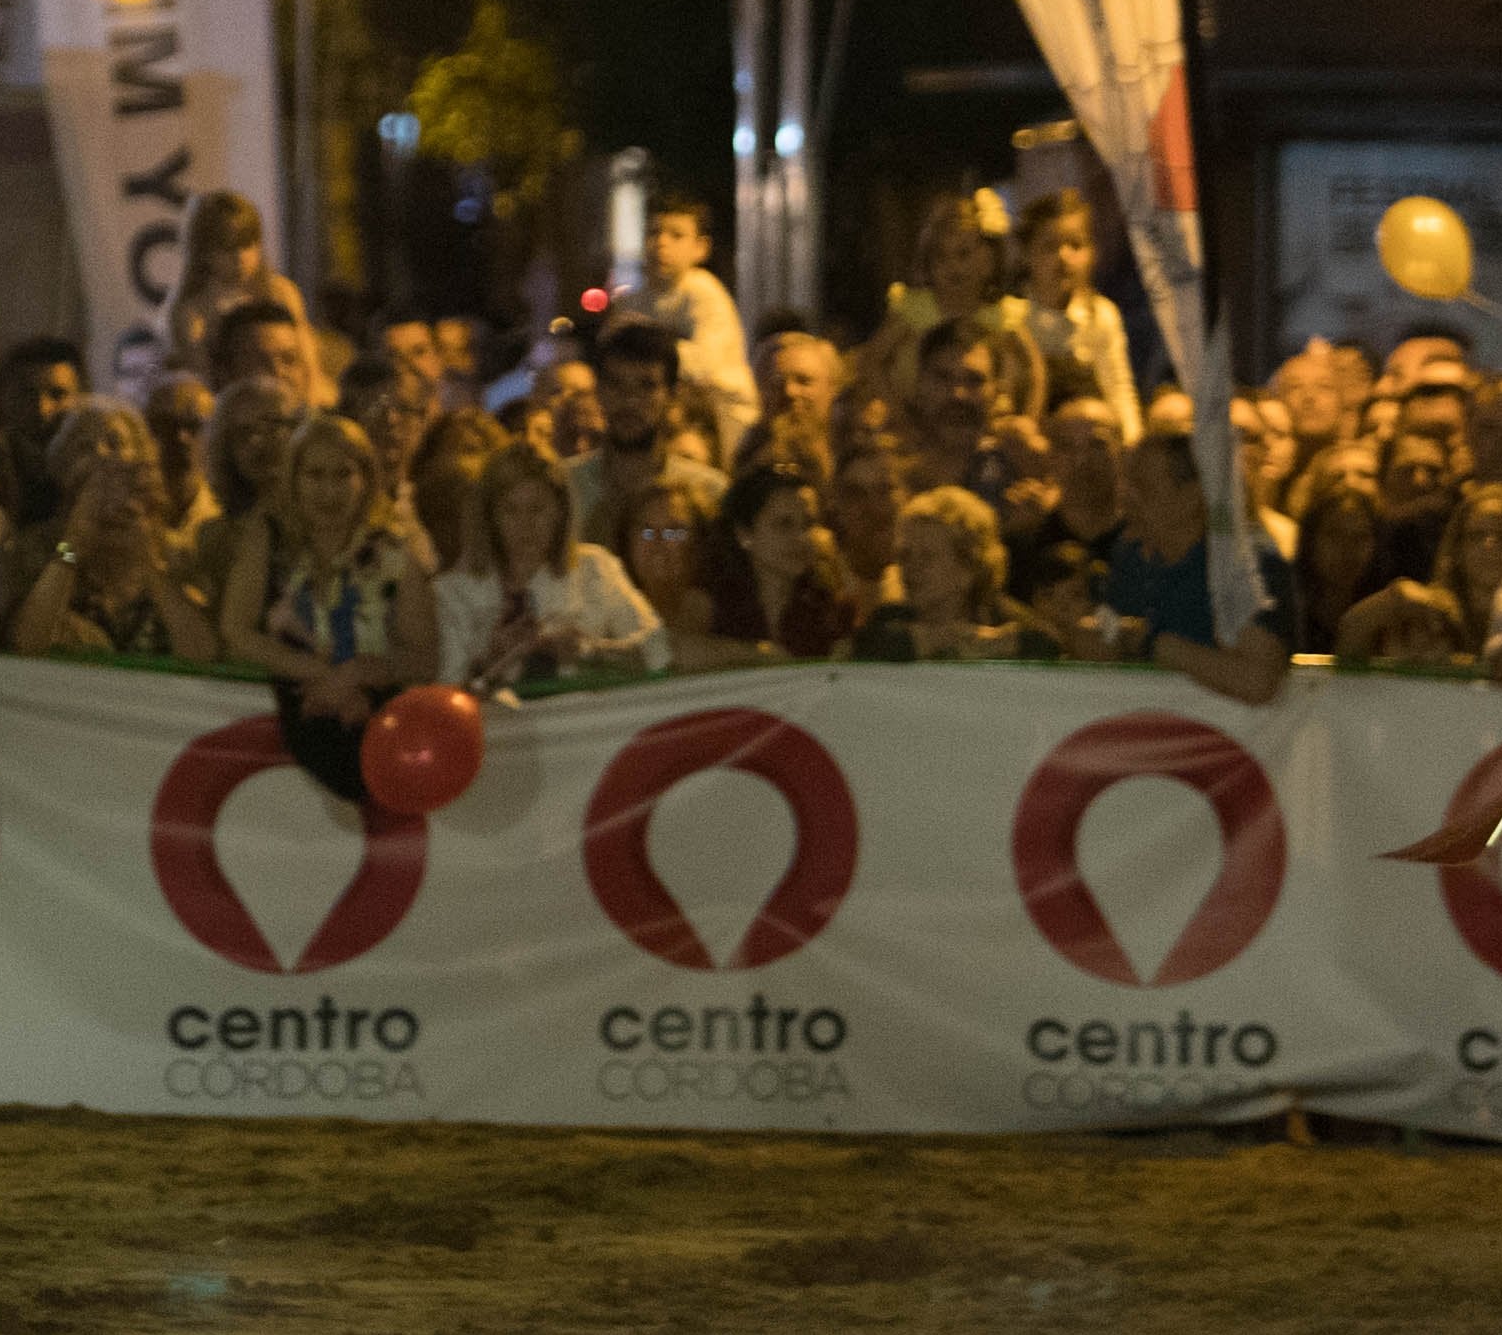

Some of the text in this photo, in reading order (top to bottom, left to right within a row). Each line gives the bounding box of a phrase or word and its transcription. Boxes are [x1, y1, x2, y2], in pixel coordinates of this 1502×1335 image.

[166, 995, 420, 1052] centro
[599, 990, 848, 1055] centro
[1025, 1009, 1279, 1068] centro
